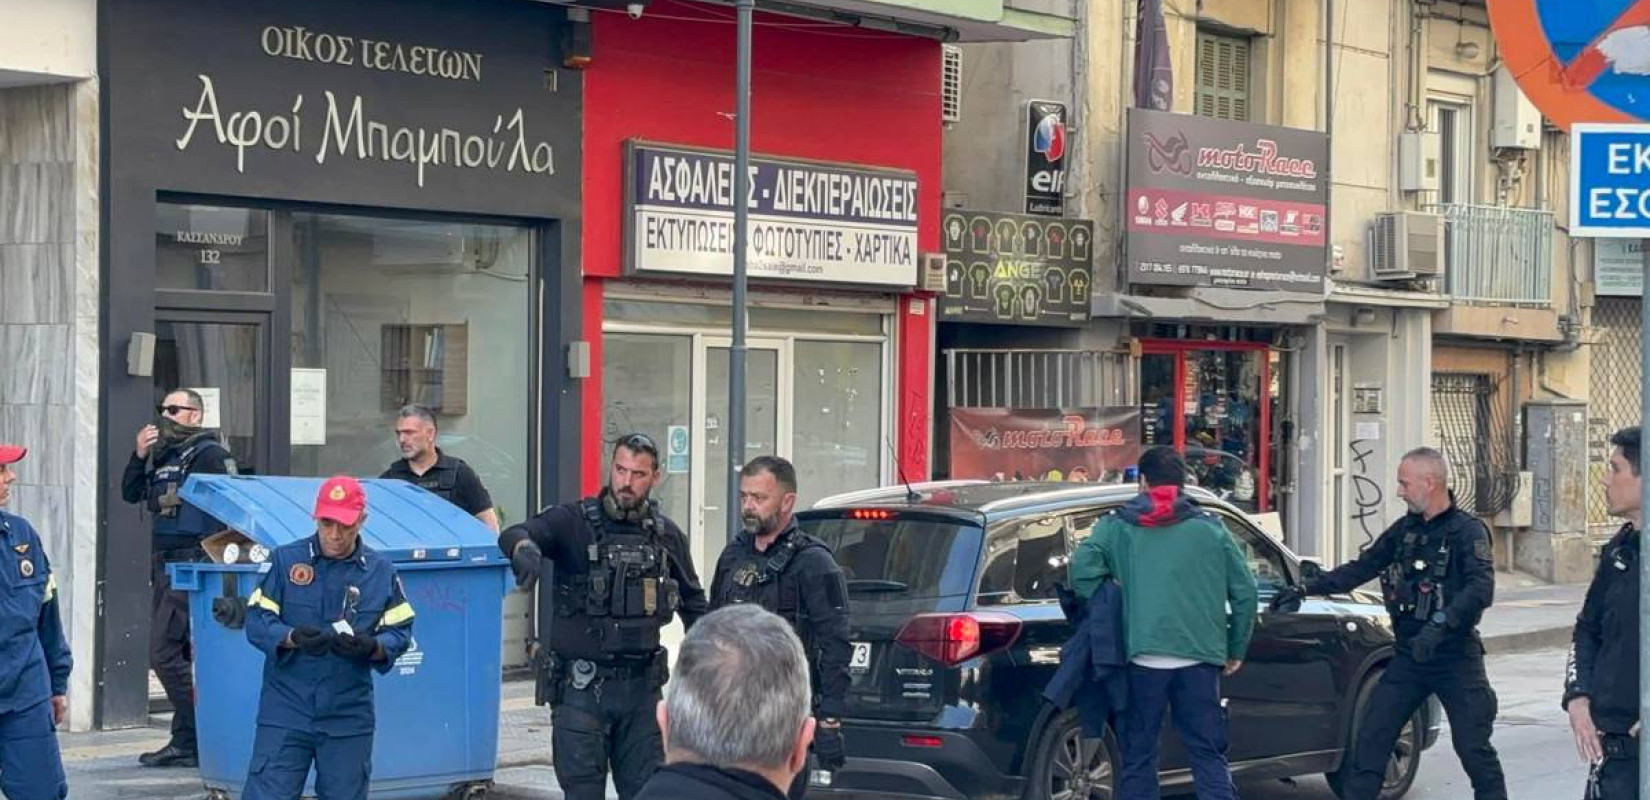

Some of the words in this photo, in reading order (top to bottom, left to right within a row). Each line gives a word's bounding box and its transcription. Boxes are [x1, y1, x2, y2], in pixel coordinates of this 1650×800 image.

[176, 75, 302, 173] Αφοί
[316, 91, 555, 188] Μπαμπούλα
[648, 156, 759, 209] ΑΣΦΑΛΕΙΣ
[773, 168, 917, 221] ΔΙΕΚΠΕΡΑΙΩΣΕΙΣ
[176, 231, 243, 245] ΚΑΣΣΑΝΔΡΟΥ
[200, 249, 220, 264] 132
[646, 216, 736, 253] ΕΚΤΥΠΩΣΕΙ
[753, 224, 843, 261] ΦΩΤΟΤΥΠΙΕΣ
[855, 232, 911, 265] ΧΑΡΤΙΚΑ
